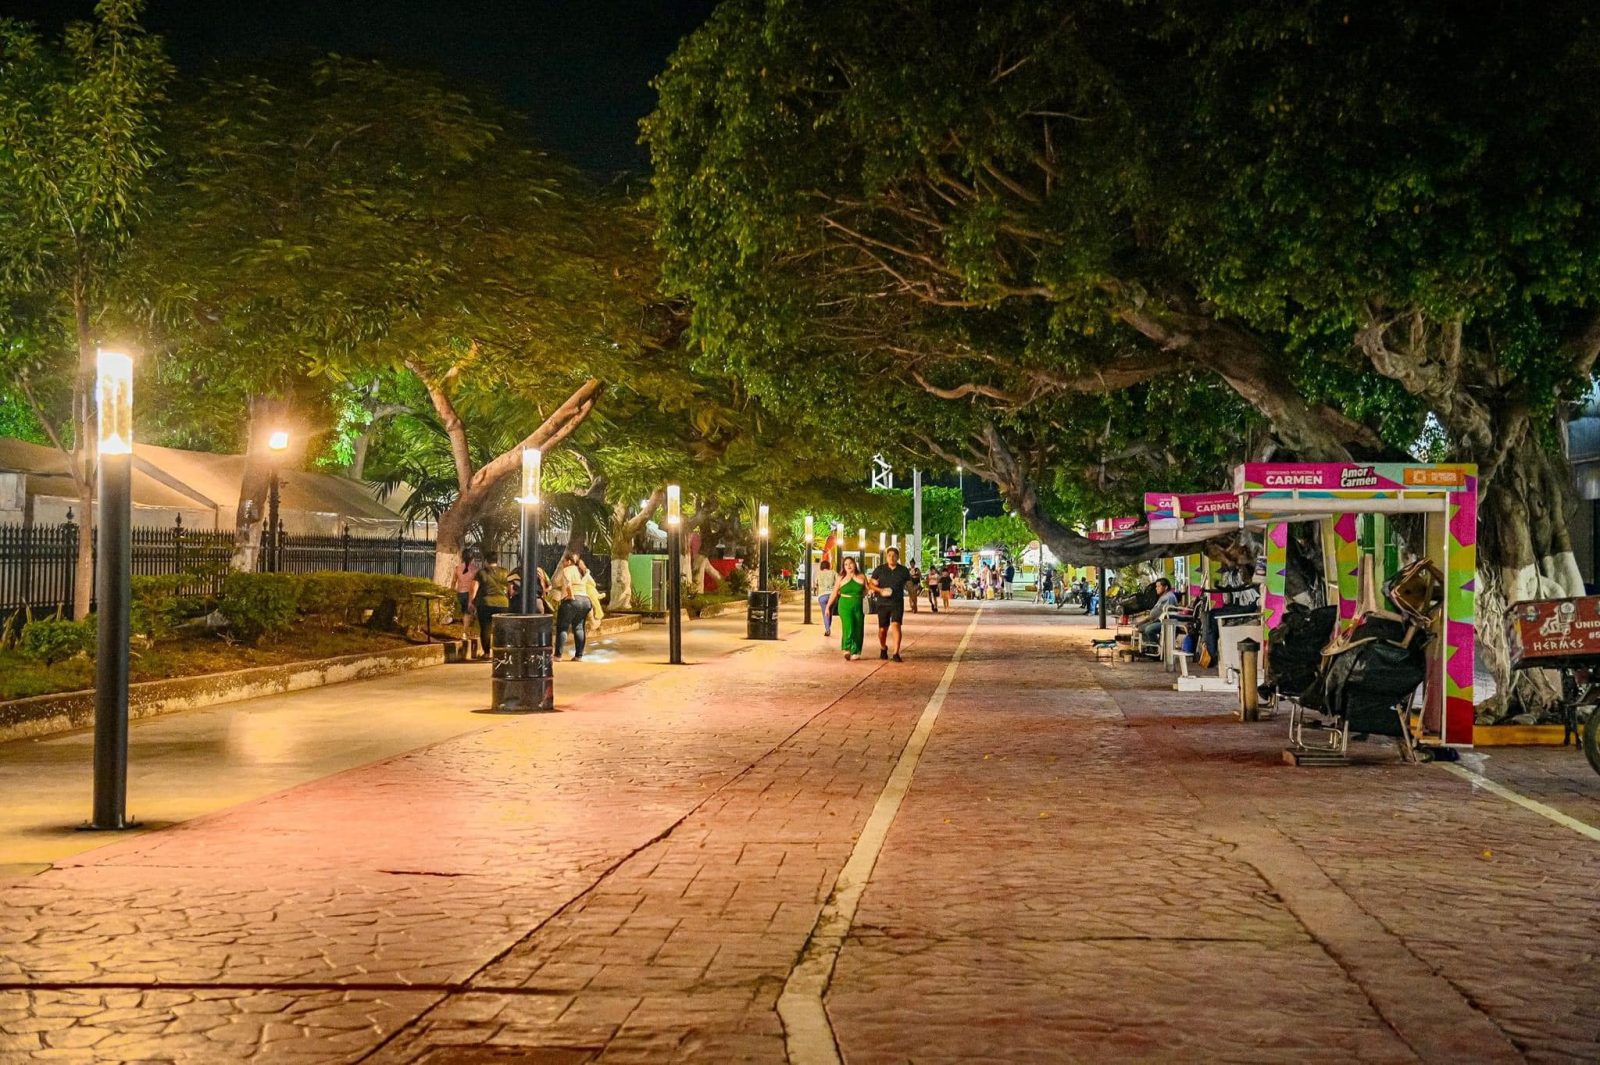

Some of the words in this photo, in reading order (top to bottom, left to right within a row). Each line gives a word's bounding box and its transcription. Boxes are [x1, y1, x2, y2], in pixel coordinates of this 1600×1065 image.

[1341, 468, 1367, 478] Amor
[1266, 475, 1323, 485] CARMEN
[1340, 476, 1377, 488] Carmen
[1196, 502, 1239, 512] CARMEN
[1533, 639, 1585, 651] HERMES
